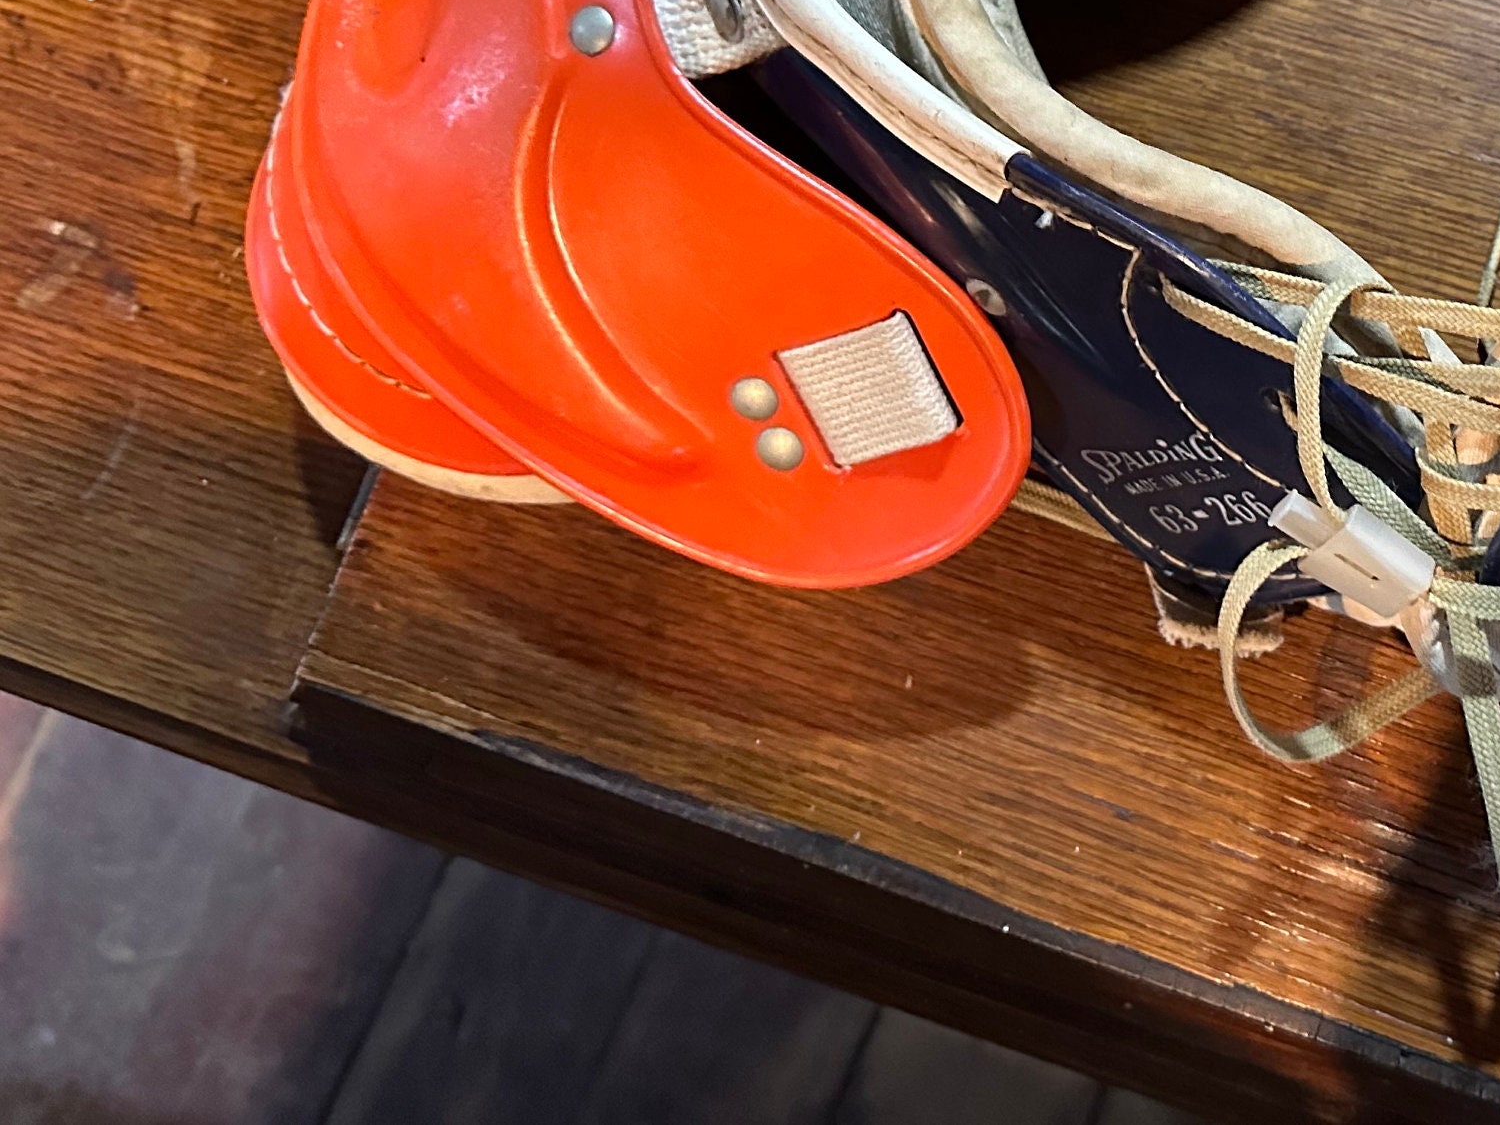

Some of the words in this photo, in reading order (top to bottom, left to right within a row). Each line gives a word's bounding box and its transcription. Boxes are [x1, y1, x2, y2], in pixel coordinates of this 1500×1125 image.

[1125, 477, 1158, 495] MADE
[1165, 473, 1181, 490] IN
[1187, 466, 1231, 485] U.S.A.
